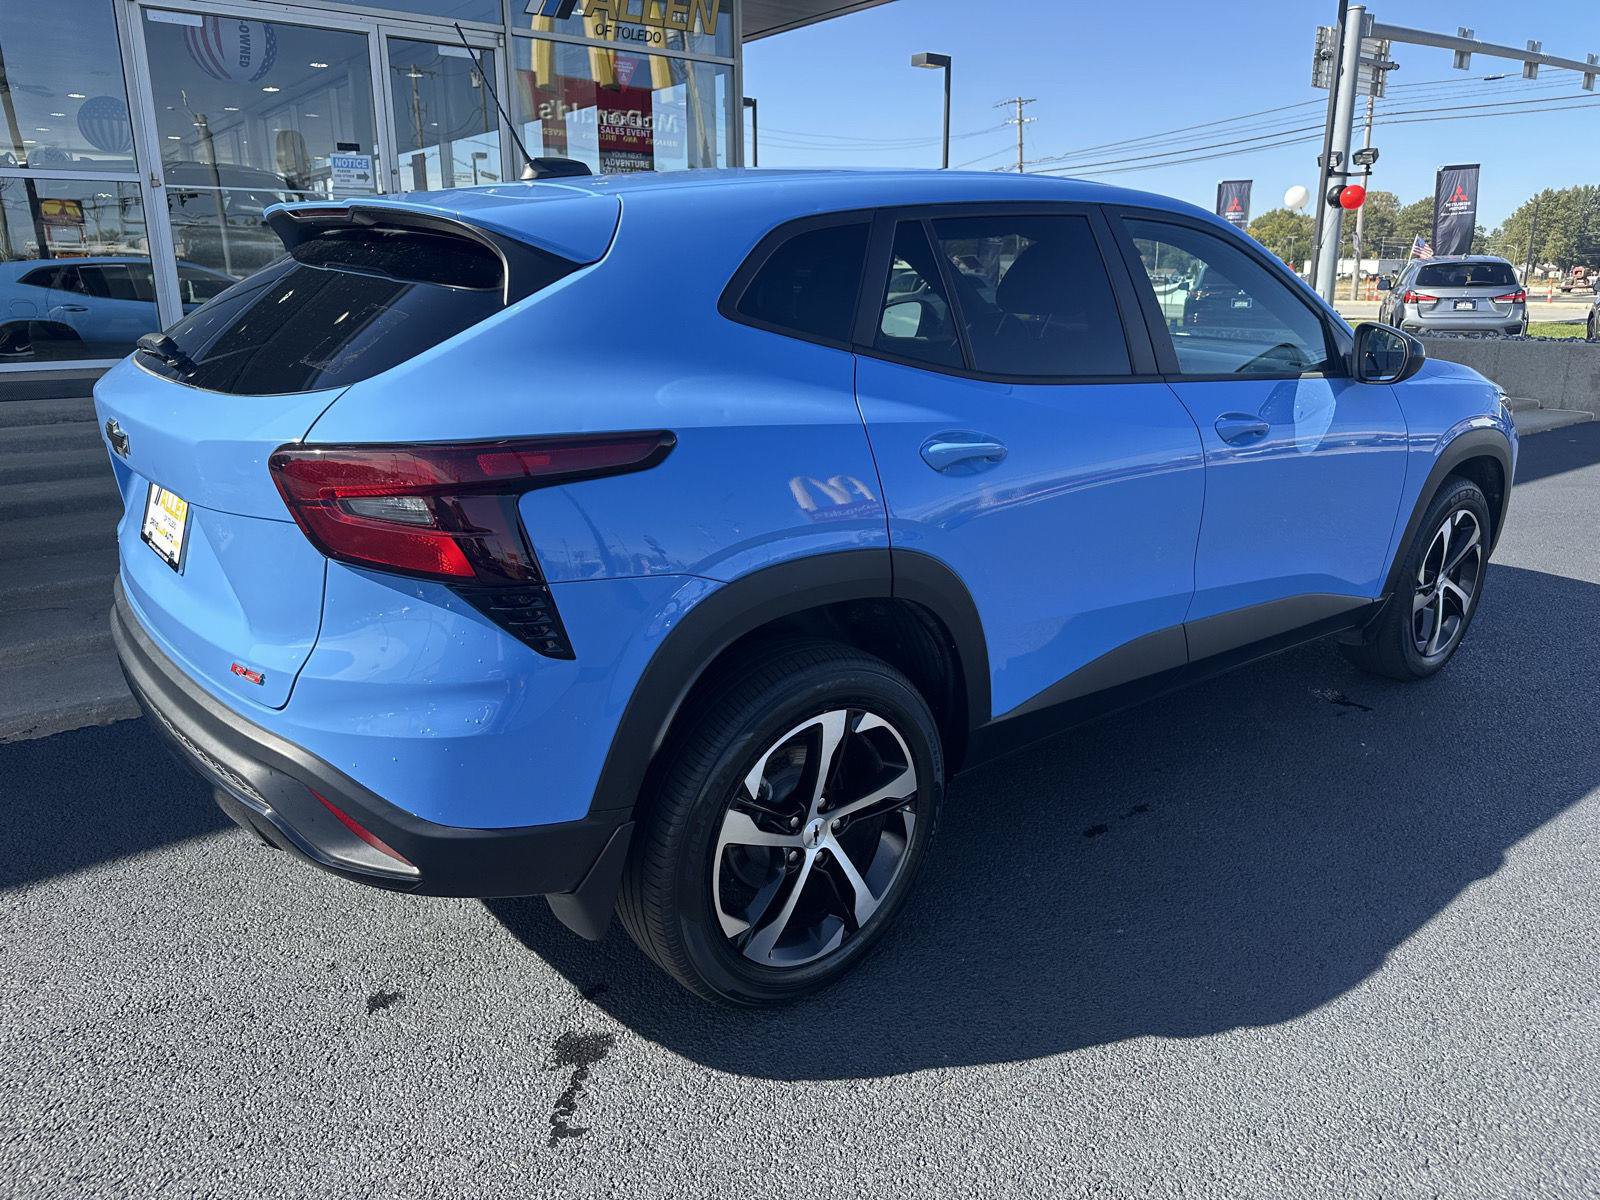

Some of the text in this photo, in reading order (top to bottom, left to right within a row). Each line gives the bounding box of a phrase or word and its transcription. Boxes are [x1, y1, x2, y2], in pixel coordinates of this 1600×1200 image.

[583, 0, 719, 35] ALLEN
[595, 23, 662, 43] OF TOLEDO
[600, 110, 651, 128] YEAR END
[600, 126, 625, 136] SALES
[626, 128, 651, 138] EVENT
[335, 158, 368, 169] NOTICE
[604, 158, 650, 169] ADVENTURE
